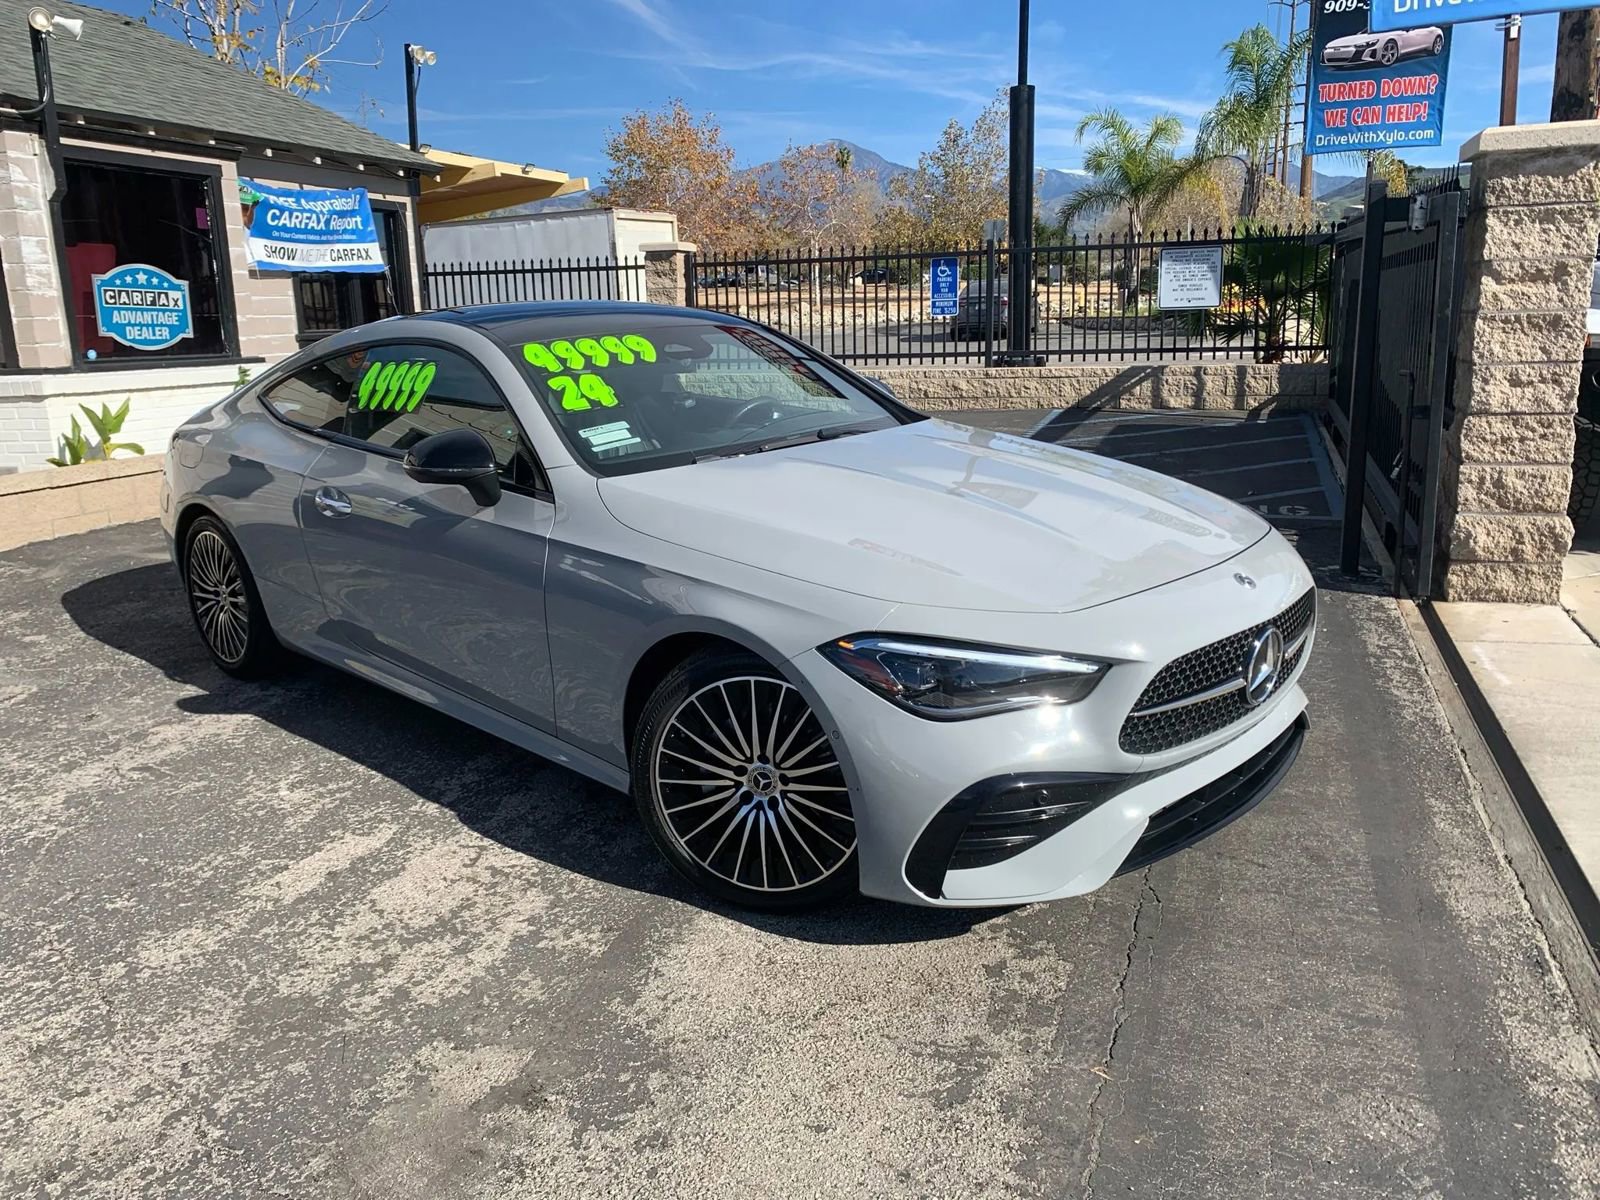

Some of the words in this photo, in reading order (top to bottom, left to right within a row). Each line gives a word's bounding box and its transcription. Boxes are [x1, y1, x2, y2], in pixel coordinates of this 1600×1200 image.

[1319, 80, 1376, 103] TURNED
[1381, 74, 1439, 98] DOWN?
[1325, 108, 1348, 128] WE
[1351, 106, 1382, 126] CAN
[1386, 101, 1429, 124] HELP!
[1316, 129, 1434, 146] DriveWithXylo.com
[301, 194, 355, 214] Appraisal
[267, 209, 326, 230] CARFAX
[330, 214, 363, 233] Report
[264, 244, 297, 261] SHOW
[299, 248, 314, 262] ME
[330, 247, 373, 262] CARFAX
[105, 291, 180, 308] CARFAX
[112, 310, 180, 325] ADVANTAGE
[125, 326, 170, 340] DEALER
[523, 334, 657, 373] 49999
[358, 361, 436, 413] 49999
[547, 374, 619, 412] 24
